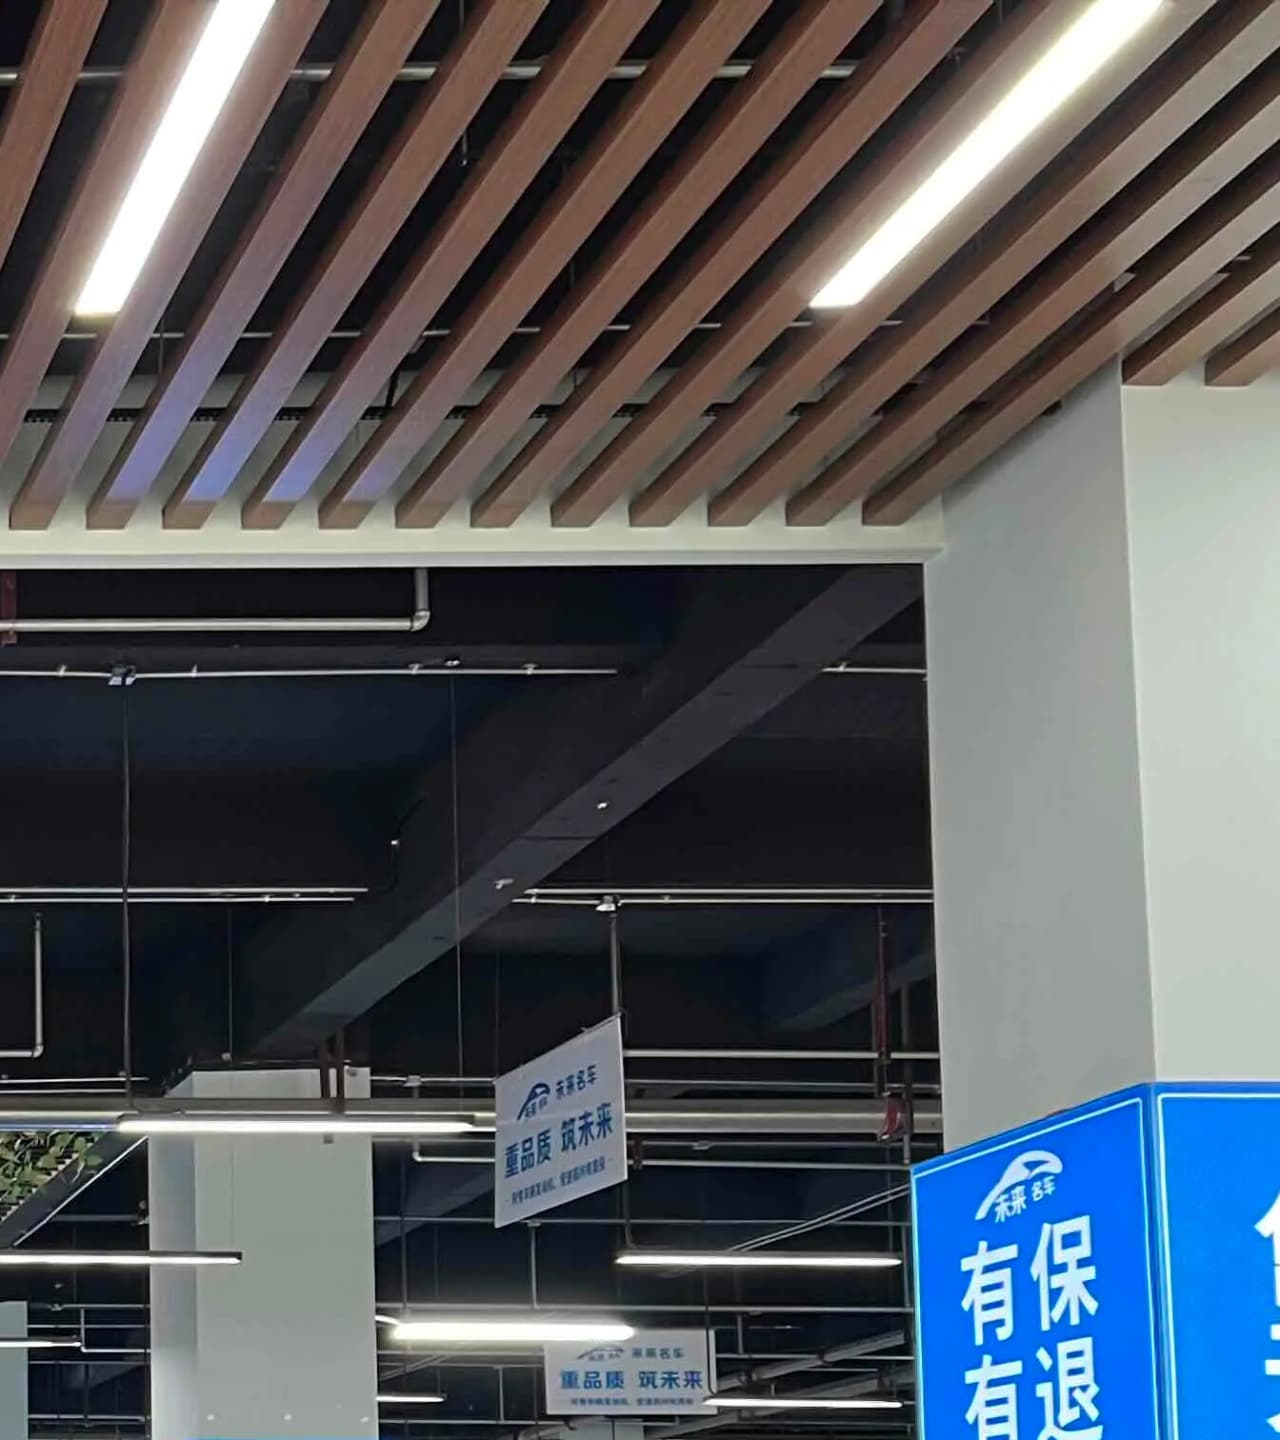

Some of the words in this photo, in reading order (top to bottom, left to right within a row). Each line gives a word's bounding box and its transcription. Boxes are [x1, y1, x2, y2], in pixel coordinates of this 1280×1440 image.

[505, 1128, 552, 1179] 重品质
[561, 1102, 614, 1152] 筑未来
[960, 1215, 1099, 1346] 有保
[561, 1370, 625, 1390] 重品质
[639, 1369, 704, 1390] 筑未来
